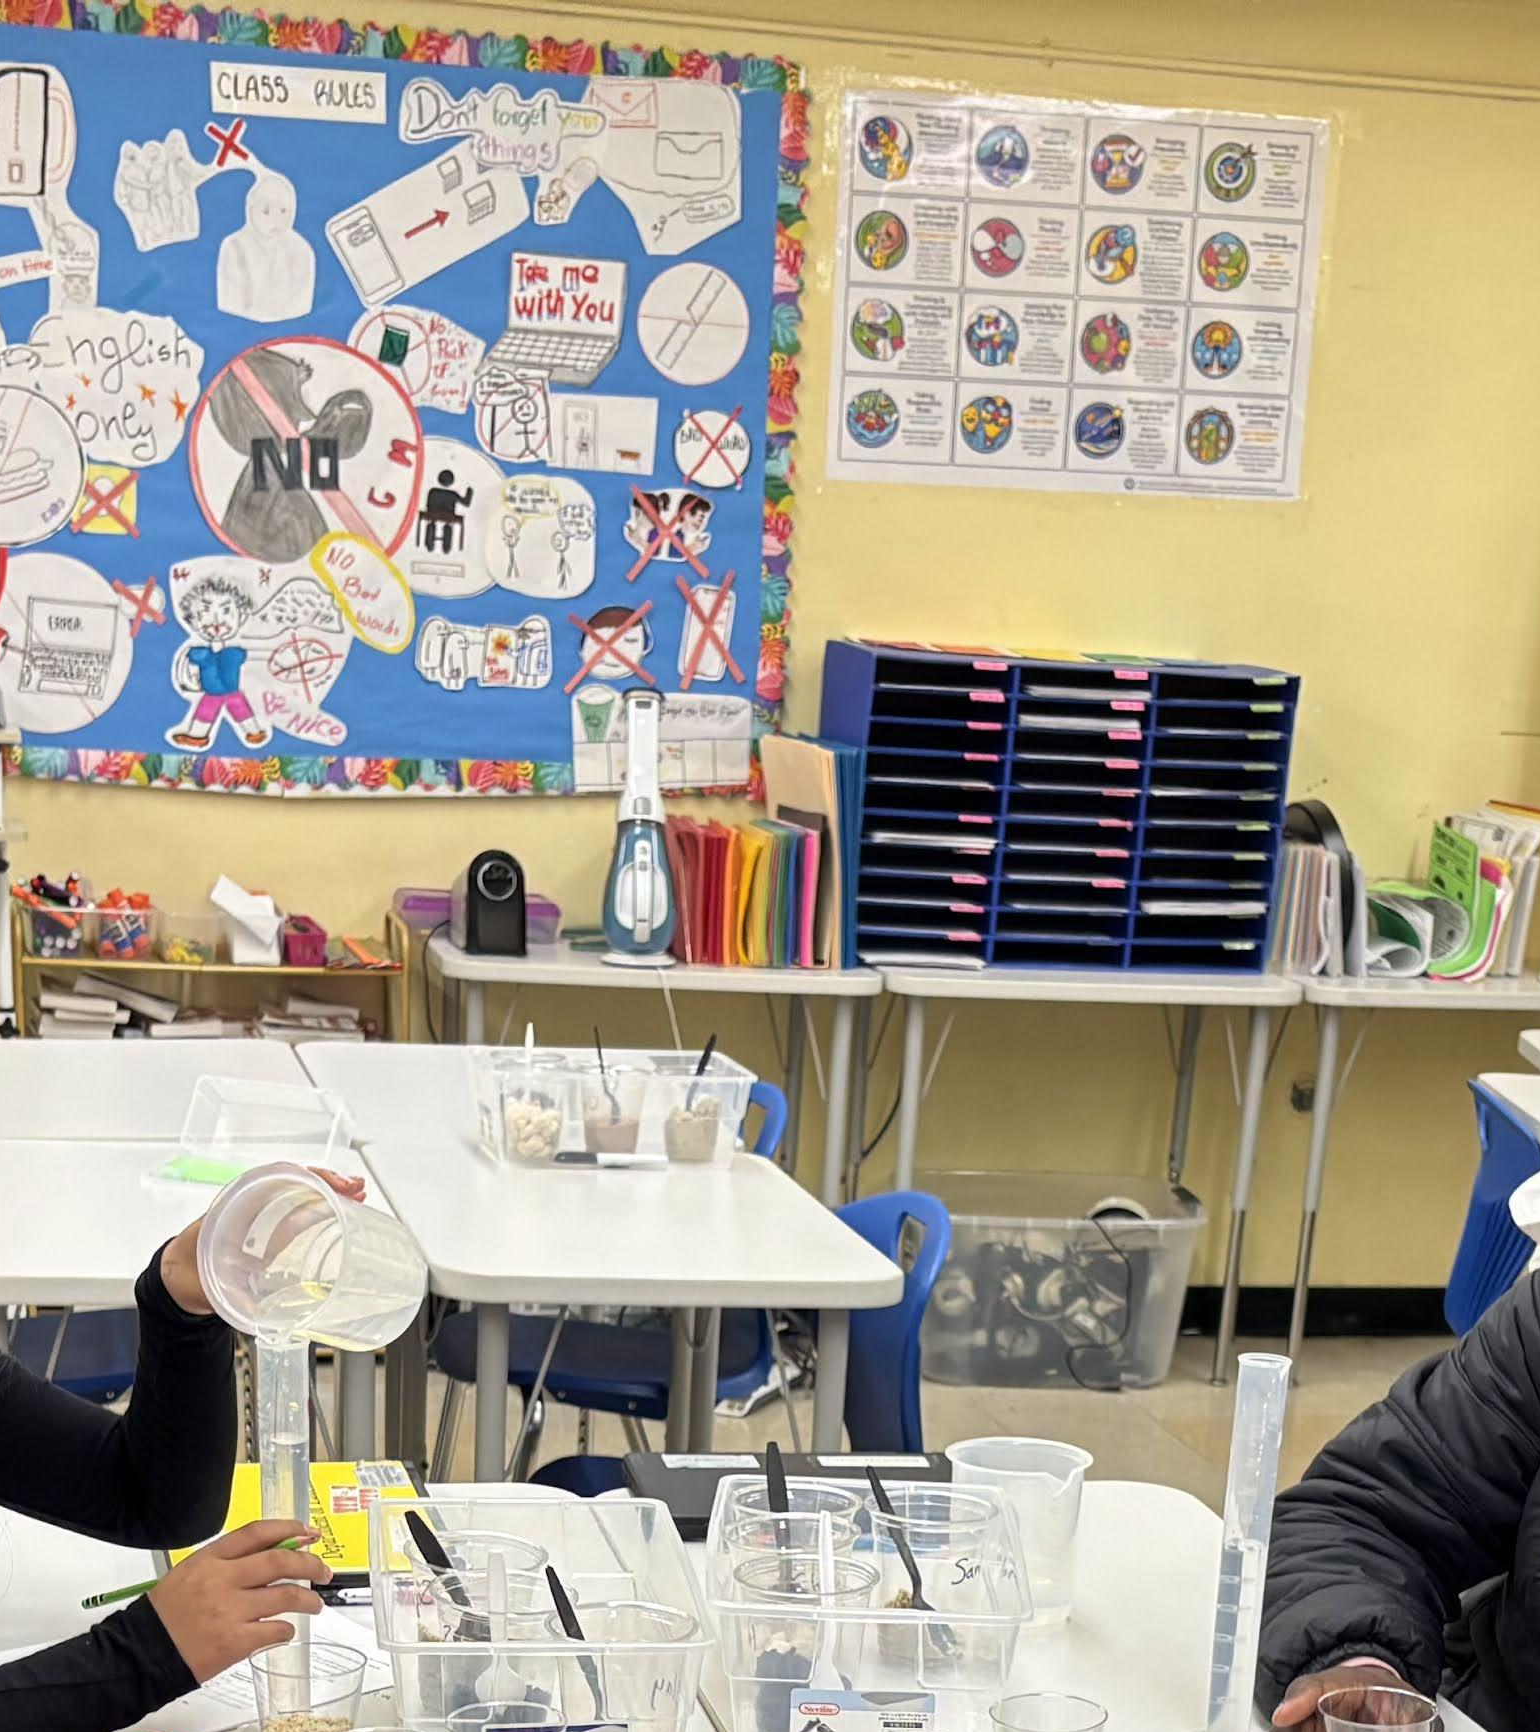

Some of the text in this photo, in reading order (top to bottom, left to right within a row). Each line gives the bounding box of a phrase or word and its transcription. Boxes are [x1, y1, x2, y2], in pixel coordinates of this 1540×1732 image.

[217, 71, 377, 110] CLASS RULES
[514, 287, 615, 324] with You
[75, 401, 158, 462] Only
[251, 437, 340, 491] NO
